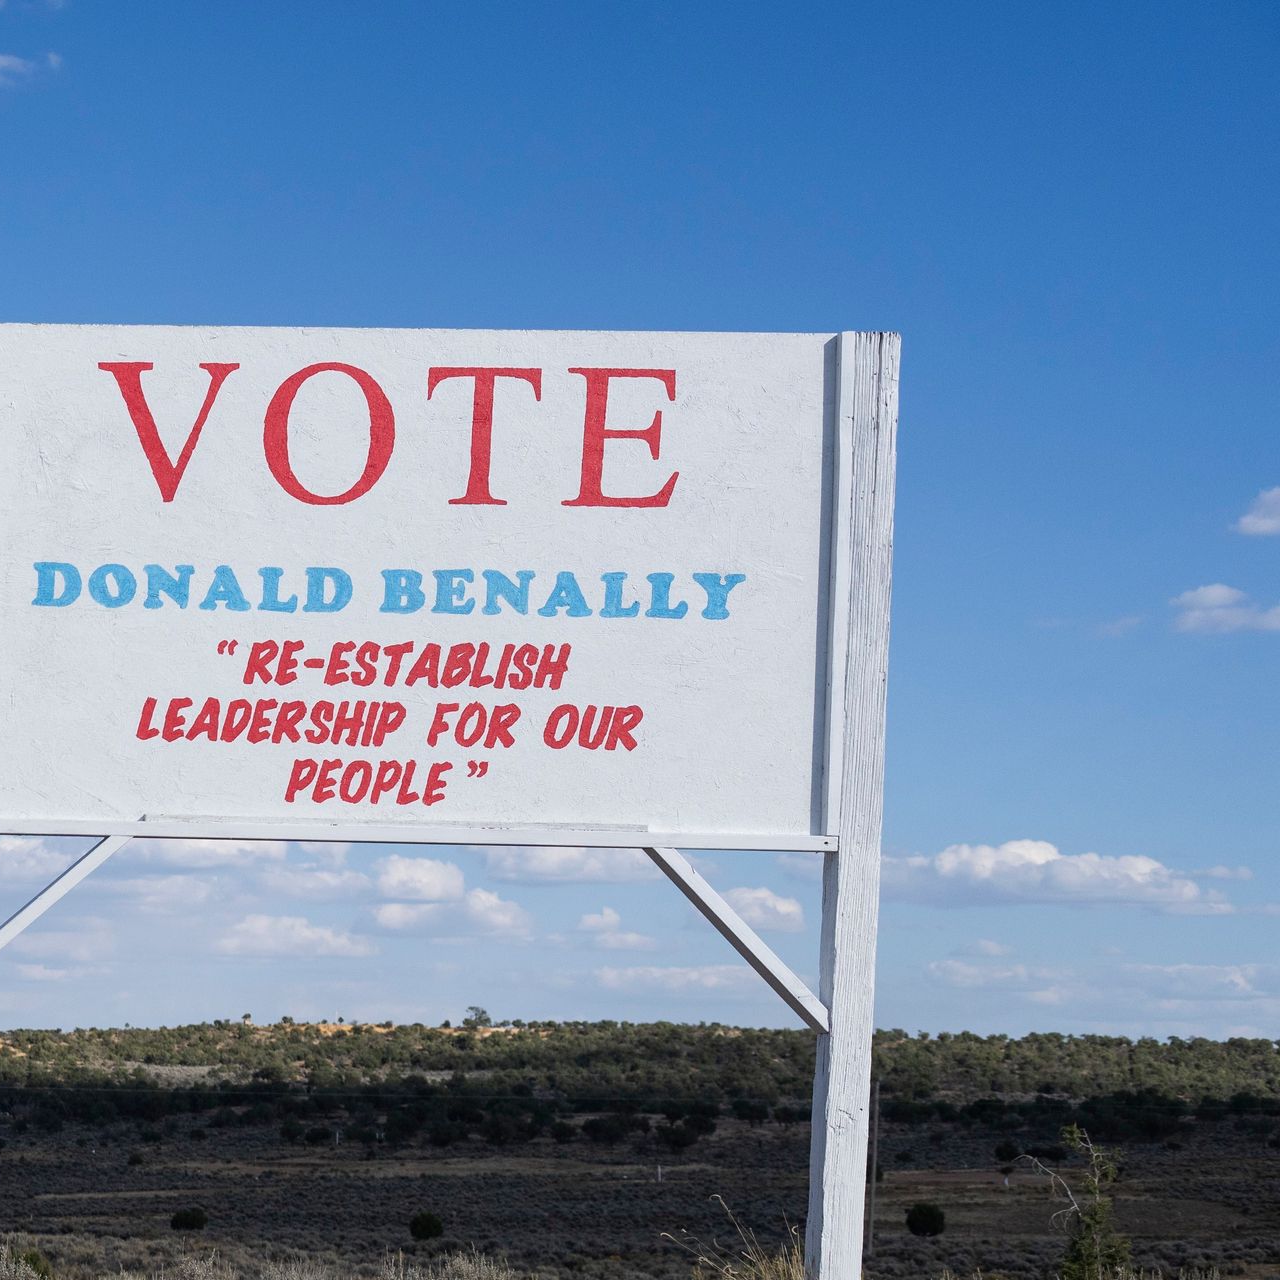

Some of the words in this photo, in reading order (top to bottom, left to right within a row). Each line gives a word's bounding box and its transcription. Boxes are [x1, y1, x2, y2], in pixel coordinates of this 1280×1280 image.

[98, 362, 679, 508] VOTE
[32, 562, 352, 613] DONALD
[380, 569, 745, 620] BENALLY
[218, 640, 572, 689] “RE-ESTABLISH
[137, 698, 407, 749] LEADERSHIP
[429, 703, 522, 748] FOR
[544, 704, 644, 751] OUR
[285, 759, 489, 805] PEOPLE”
